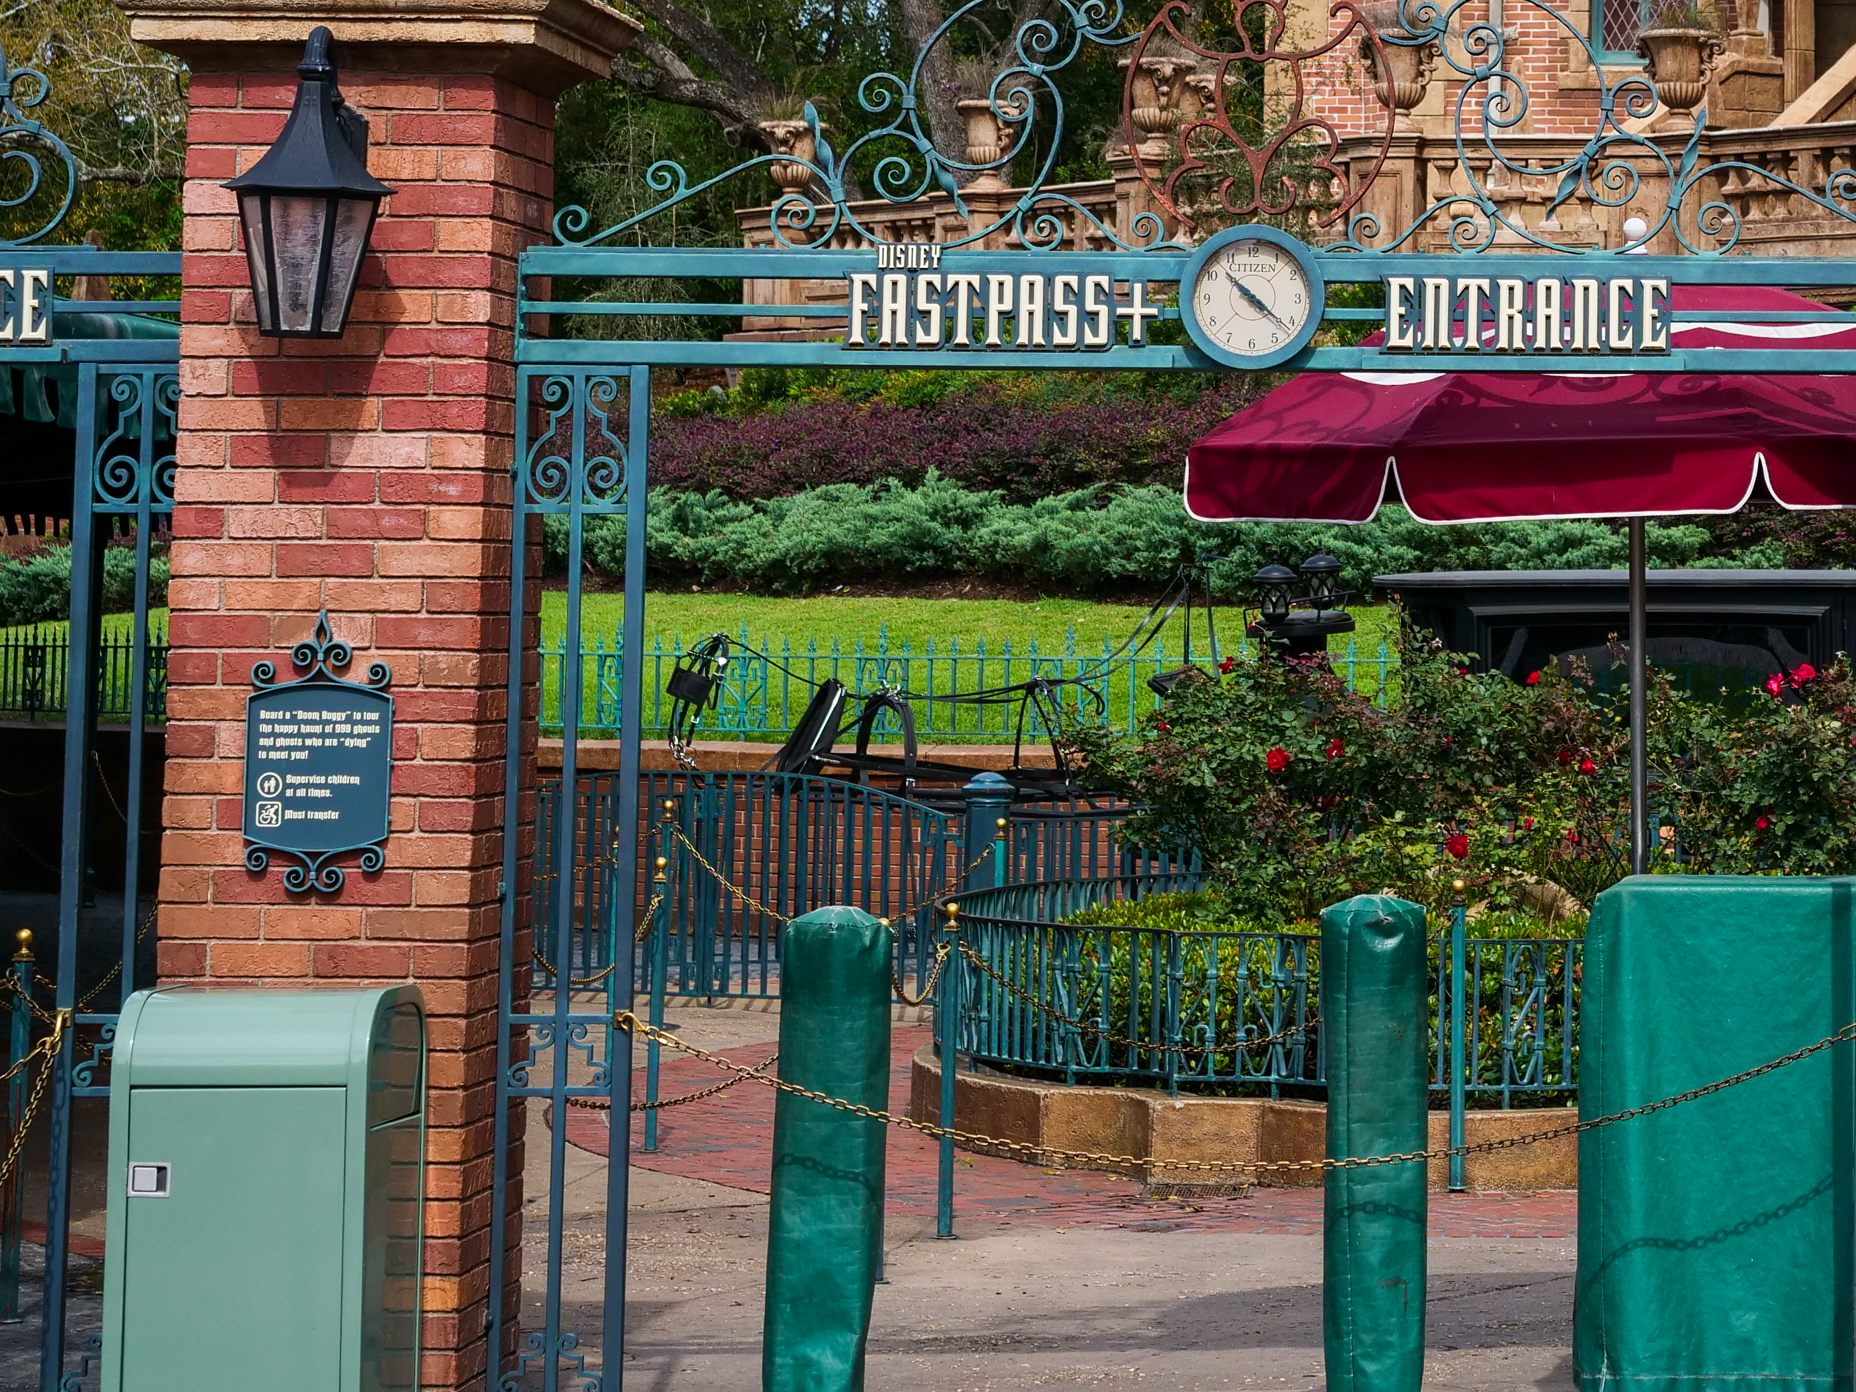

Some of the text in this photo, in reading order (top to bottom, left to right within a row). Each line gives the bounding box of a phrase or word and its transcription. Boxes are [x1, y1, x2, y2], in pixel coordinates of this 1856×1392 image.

[878, 244, 942, 270] DISNEY
[1247, 247, 1259, 258] 12
[1229, 263, 1277, 273] CITIZEN
[1207, 270, 1218, 281] 10
[1289, 270, 1297, 281] 2
[1203, 293, 1211, 305] 9
[1294, 293, 1302, 305] 3
[849, 273, 1159, 346] FASTPASS+
[1386, 277, 1668, 351] ENTRANCE
[1209, 315, 1217, 327] 8
[1226, 332, 1233, 343] 7
[1270, 332, 1279, 344] 5
[1248, 338, 1256, 350] 6
[260, 710, 283, 719] Board
[353, 712, 361, 720] to
[363, 712, 379, 720] tour
[259, 724, 380, 734] the happy haunt of 999 ghouls
[259, 737, 274, 747] and
[275, 737, 303, 747] ghosts
[305, 737, 322, 747] who
[324, 738, 338, 746] are
[258, 750, 308, 760] to meet you!
[286, 774, 360, 785] Supervise children
[285, 788, 332, 798] at all times.
[284, 810, 339, 820] Must transfer
